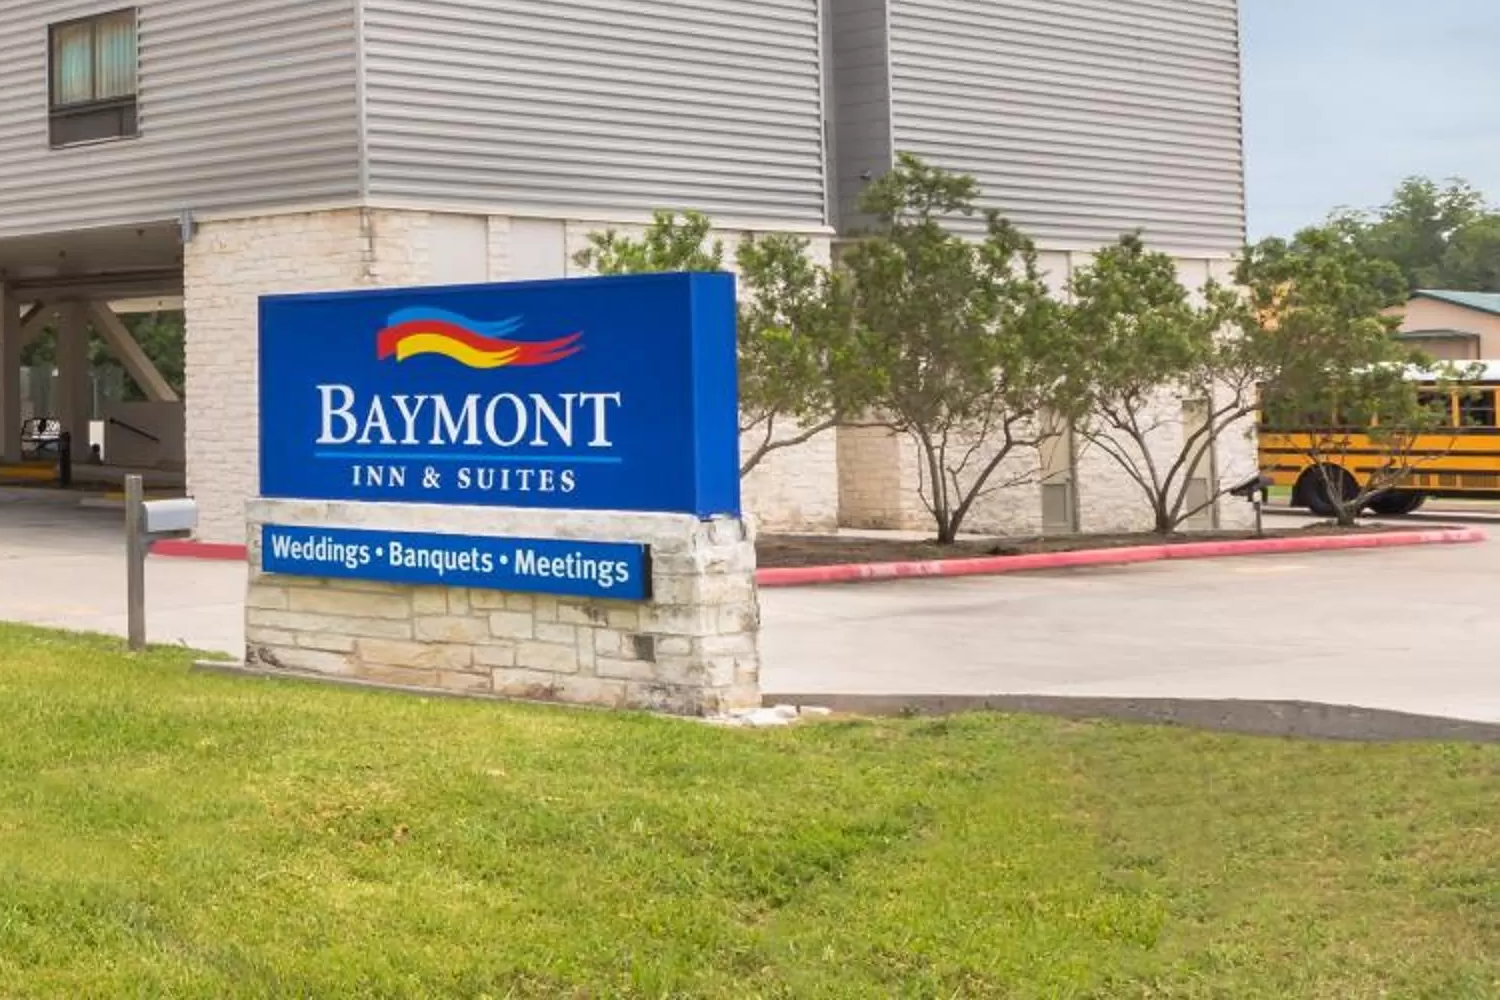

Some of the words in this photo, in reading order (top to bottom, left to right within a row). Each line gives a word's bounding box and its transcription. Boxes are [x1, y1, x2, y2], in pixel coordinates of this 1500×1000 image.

[315, 384, 621, 447] BAYMONT
[352, 465, 407, 487] INN
[423, 466, 441, 488] &
[457, 468, 576, 492] SUITES
[271, 534, 370, 567] Weddings
[388, 542, 493, 576] Banquets
[514, 548, 629, 587] Meetings
